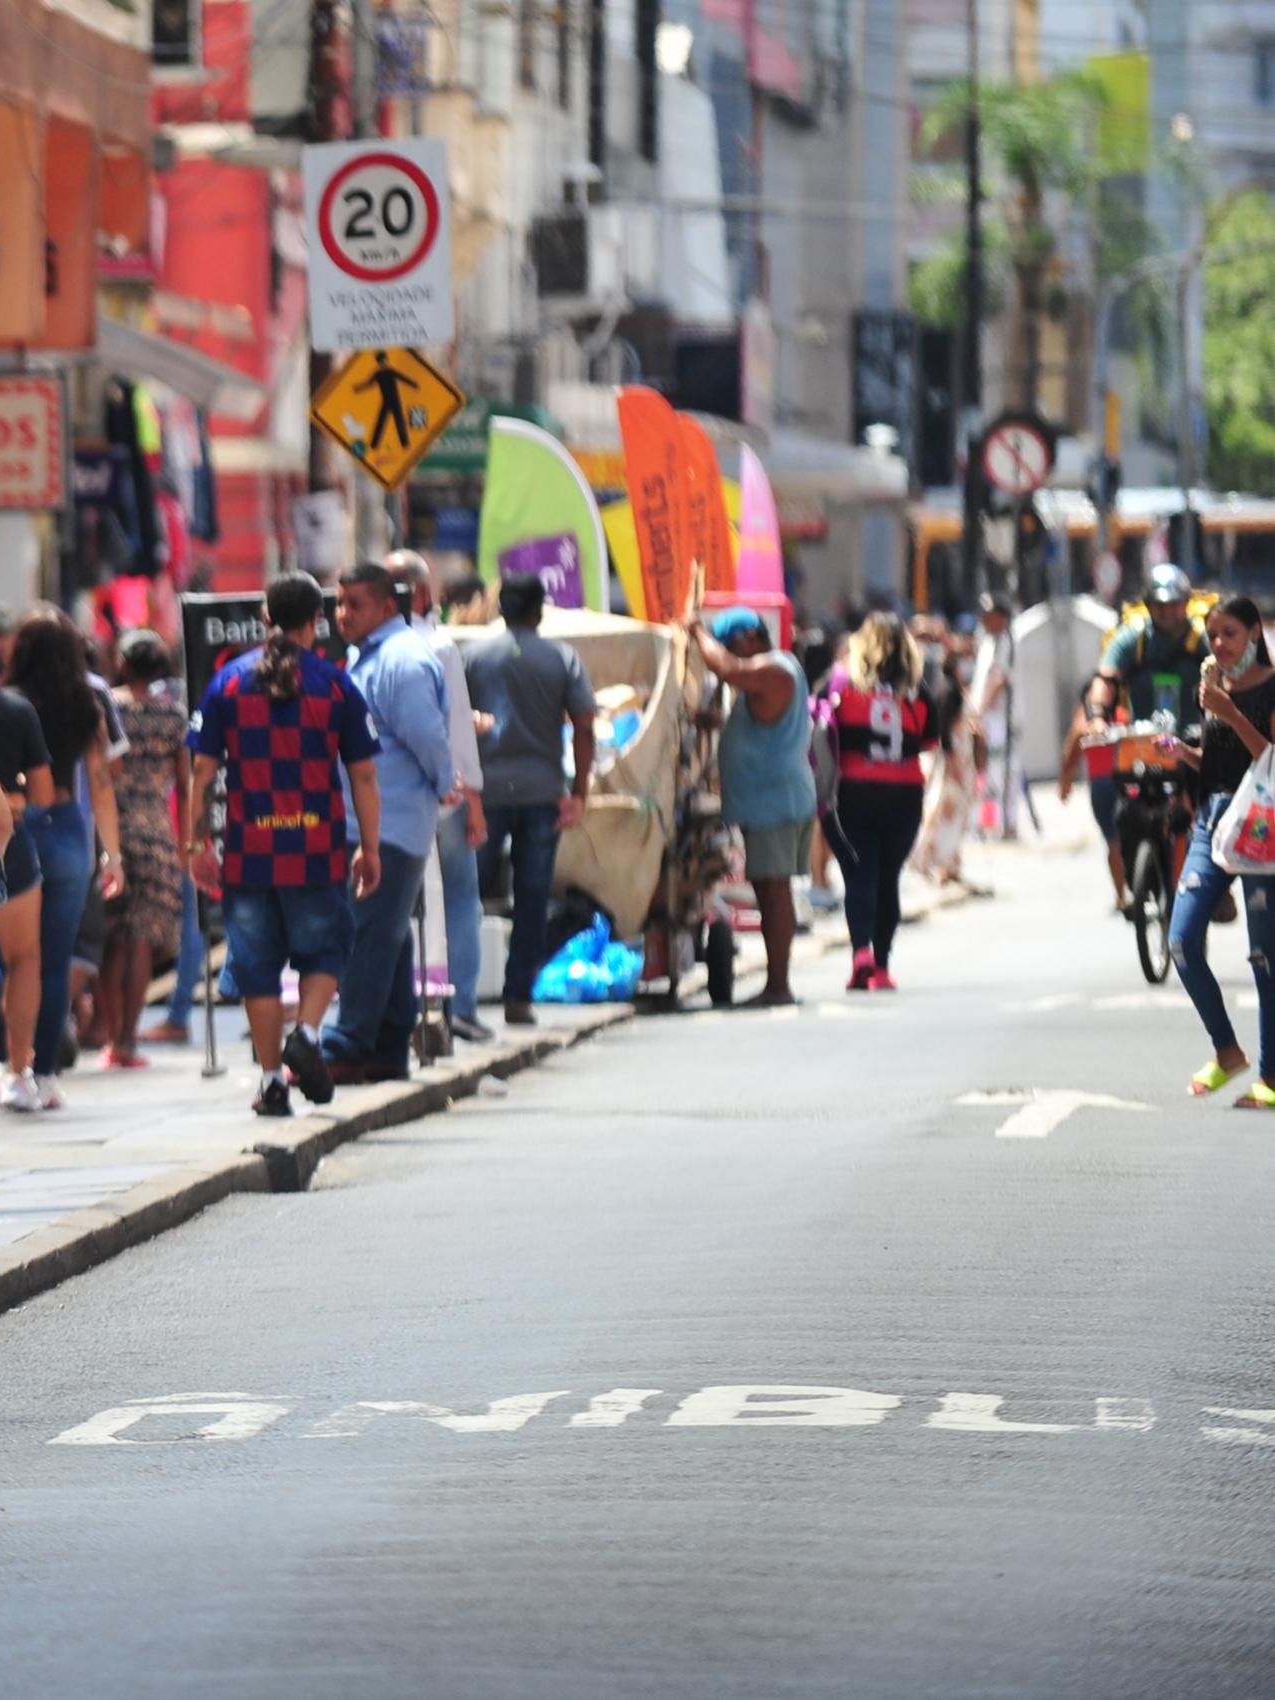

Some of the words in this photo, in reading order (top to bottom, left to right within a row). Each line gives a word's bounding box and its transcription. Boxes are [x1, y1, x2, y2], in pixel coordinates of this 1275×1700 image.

[342, 186, 415, 239] 20
[329, 284, 434, 306] VELOCIDADE
[337, 326, 429, 344] PERMITIDA
[869, 698, 903, 763] 9
[255, 810, 302, 830] unicef
